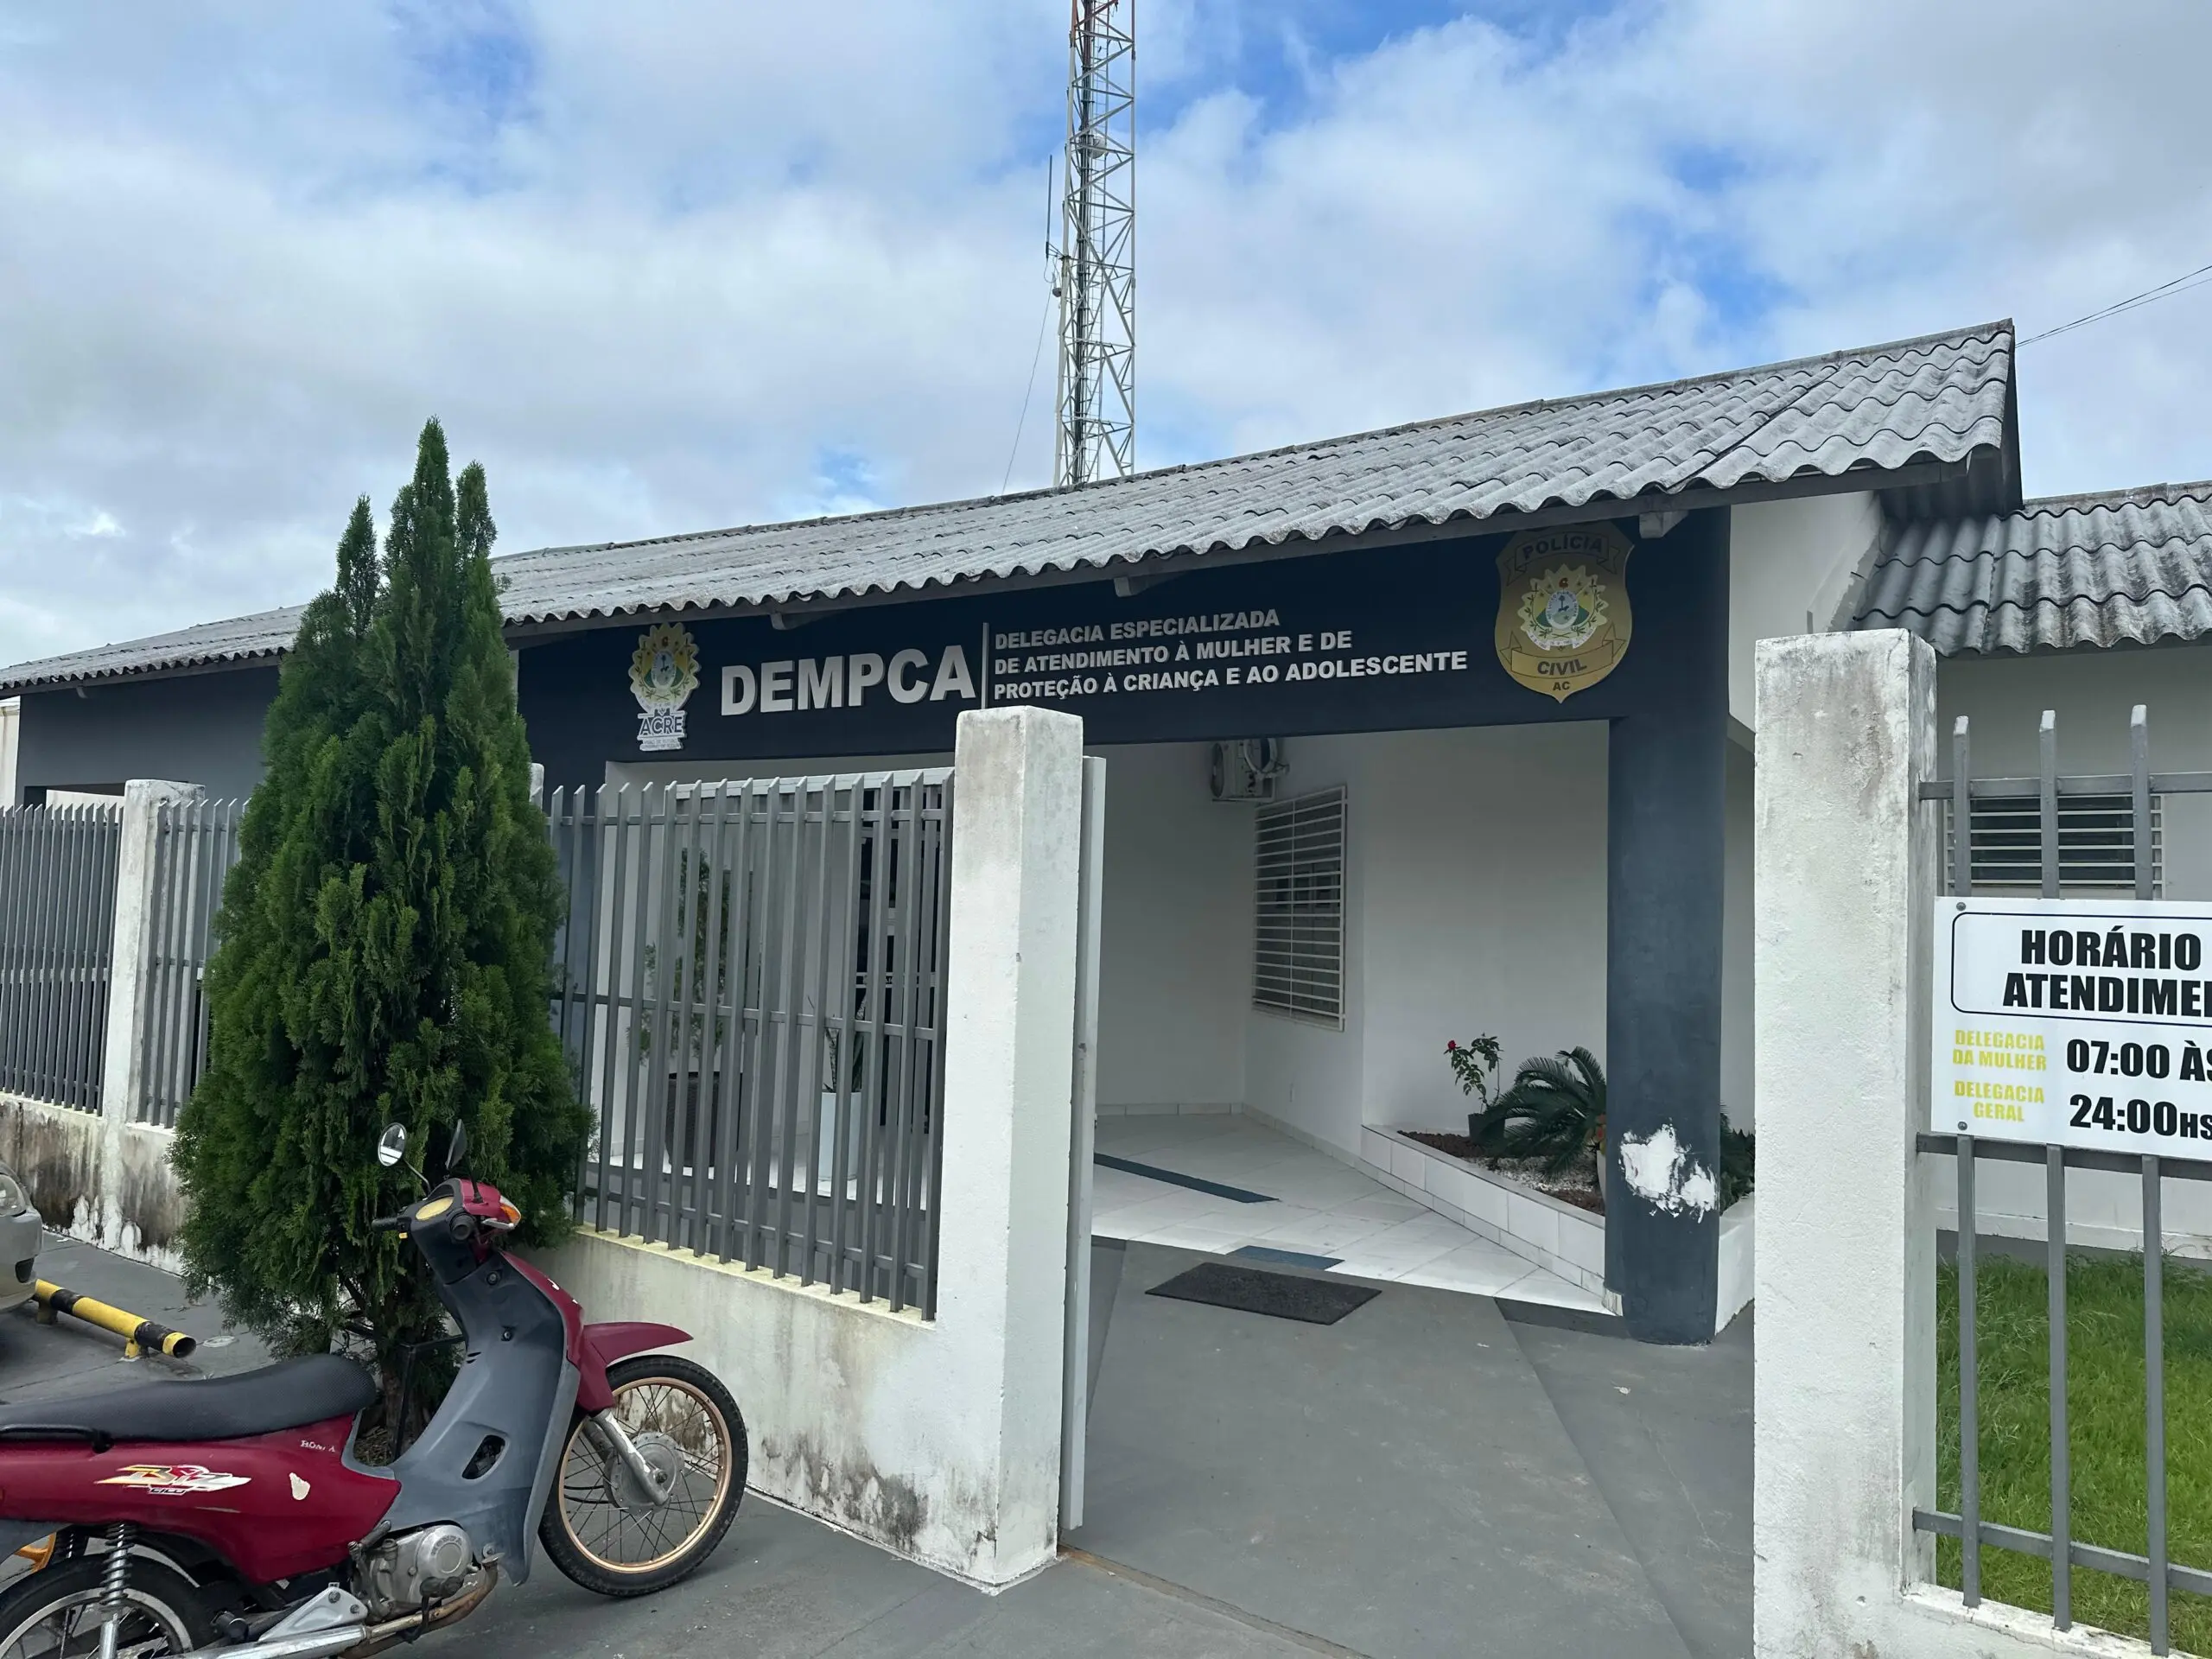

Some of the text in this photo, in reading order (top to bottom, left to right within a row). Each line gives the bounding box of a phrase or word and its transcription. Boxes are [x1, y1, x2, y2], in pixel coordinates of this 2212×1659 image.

[995, 608, 1281, 650] DELEGACIA ESPECIALIZADA
[995, 630, 1352, 675] DE ATENDIMENTO À MULHER E DE
[995, 651, 1468, 700] PROTEÇÃO À CRIANÇA E AO ADOLESCENTE
[1536, 658, 1587, 676] CIVIL
[721, 645, 976, 716] DEMPCA
[1553, 681, 1571, 691] AC
[640, 715, 683, 735] ACRE
[2021, 925, 2202, 971] HORÁRIO
[1955, 1029, 2045, 1051] DELEGACIA
[1953, 1048, 2047, 1071] DA MULHER
[2067, 1039, 2170, 1079] 07:00
[1954, 1080, 2045, 1104] DELEGACIA
[1974, 1101, 2025, 1122] GERAL
